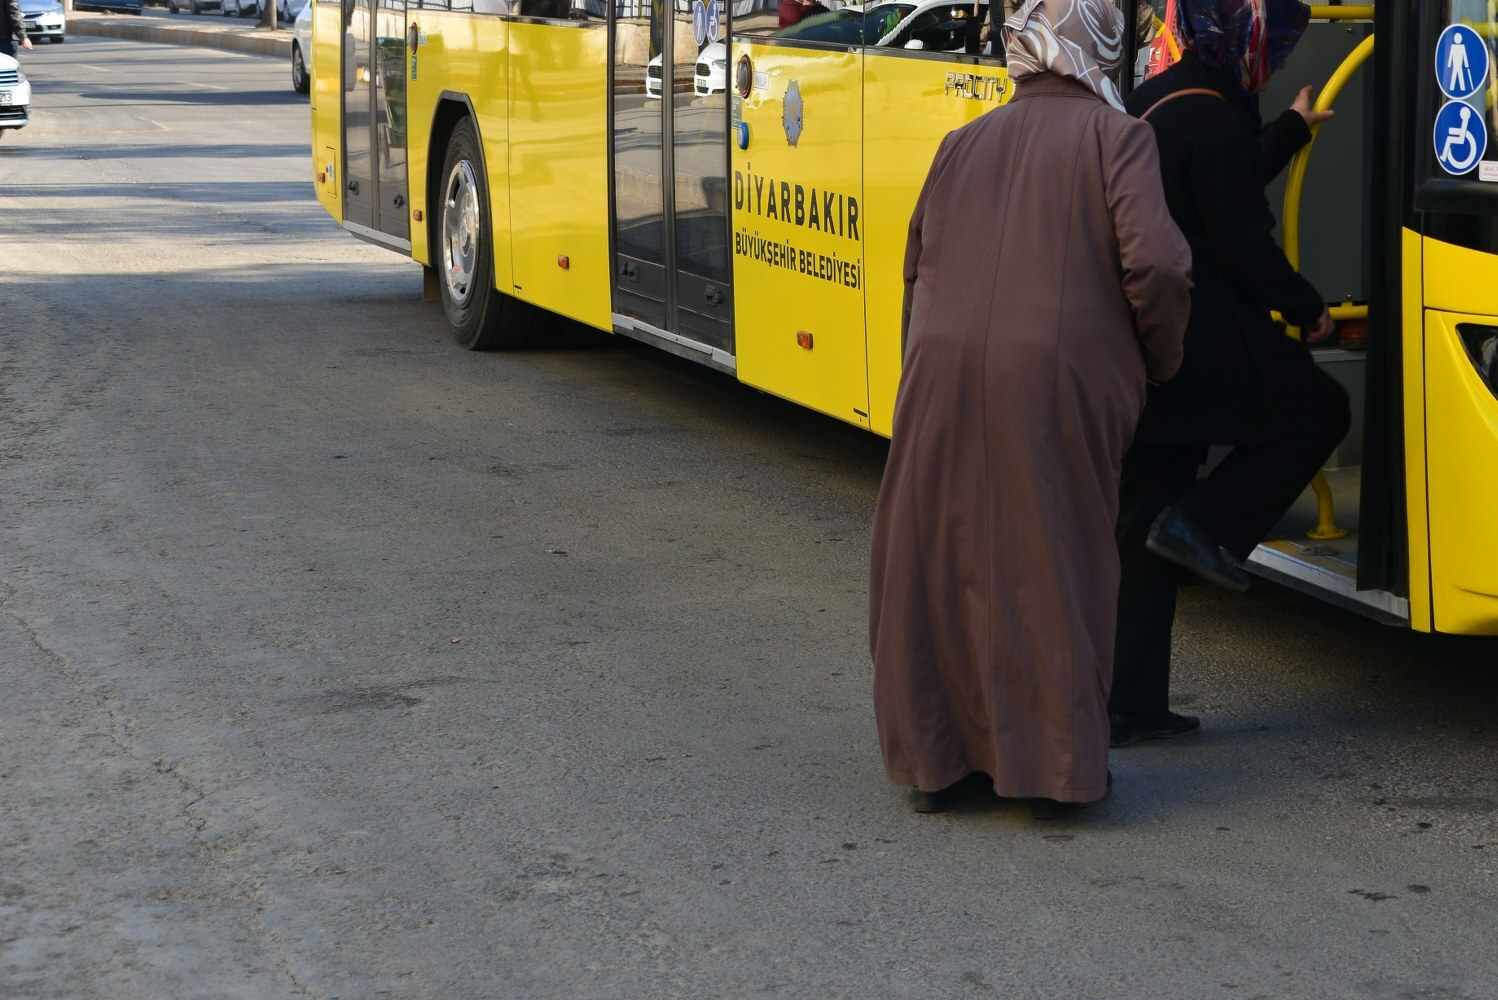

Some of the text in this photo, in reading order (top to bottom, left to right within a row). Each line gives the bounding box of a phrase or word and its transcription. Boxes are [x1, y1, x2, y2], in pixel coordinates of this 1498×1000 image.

[945, 72, 1007, 102] PROCITY
[735, 161, 860, 241] DİYARBAKIR
[735, 227, 861, 290] BÜYÜKŞEHİR BELEDİYESİ
